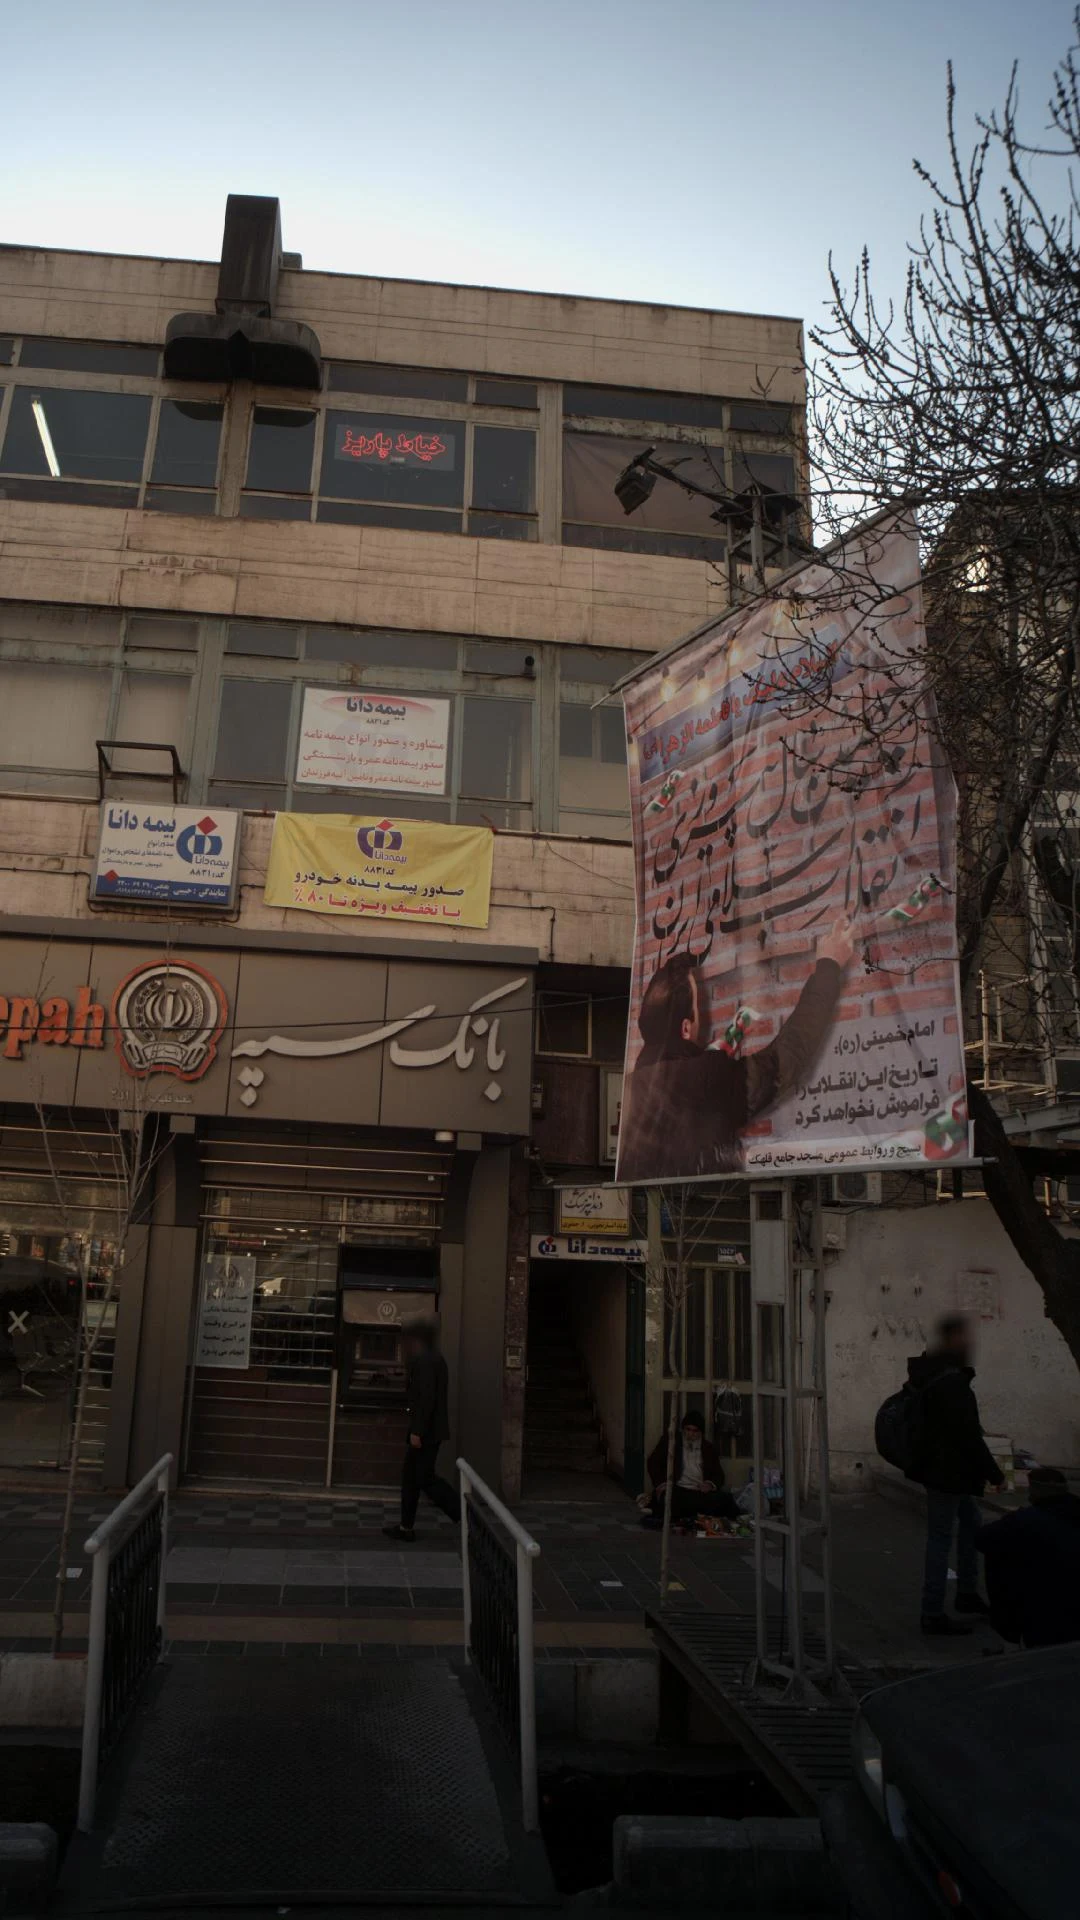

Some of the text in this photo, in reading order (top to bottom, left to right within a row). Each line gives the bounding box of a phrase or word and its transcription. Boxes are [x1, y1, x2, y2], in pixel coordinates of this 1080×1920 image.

[395, 434, 446, 461] خیاط
[346, 697, 406, 720] بیمه دانا
[693, 698, 731, 735] فاطمه
[347, 734, 371, 745] انواع
[372, 738, 399, 747] صدور
[410, 740, 445, 750] مشاوره
[108, 808, 176, 839] بیمه دانا
[195, 856, 229, 870] بیمه دانا
[374, 850, 408, 864] بیمه دانا
[364, 866, 385, 874] ۸۸۳۱
[294, 871, 465, 898] صدور بیمه بدنه خودرو
[199, 888, 226, 898] نمایندگی
[307, 890, 324, 902] ۸۰
[328, 893, 347, 906] تا
[350, 898, 388, 914] ویژه
[391, 900, 438, 916] تخفیف
[442, 905, 461, 919] با
[861, 1025, 907, 1052] خمینی
[907, 1020, 935, 1046] امام
[231, 977, 527, 1107] بانک سپه
[795, 1058, 938, 1100] تاریخ این انقلاب را
[796, 1090, 940, 1129] فراموش نخواهد کرد
[773, 1152, 795, 1166] جامع
[797, 1153, 824, 1163] مسجد
[825, 1149, 858, 1164] عمومی
[860, 1144, 889, 1159] روابط
[896, 1144, 921, 1159] بسیج
[749, 1153, 773, 1166] قلهک
[568, 1238, 642, 1261] بیمه دانا
